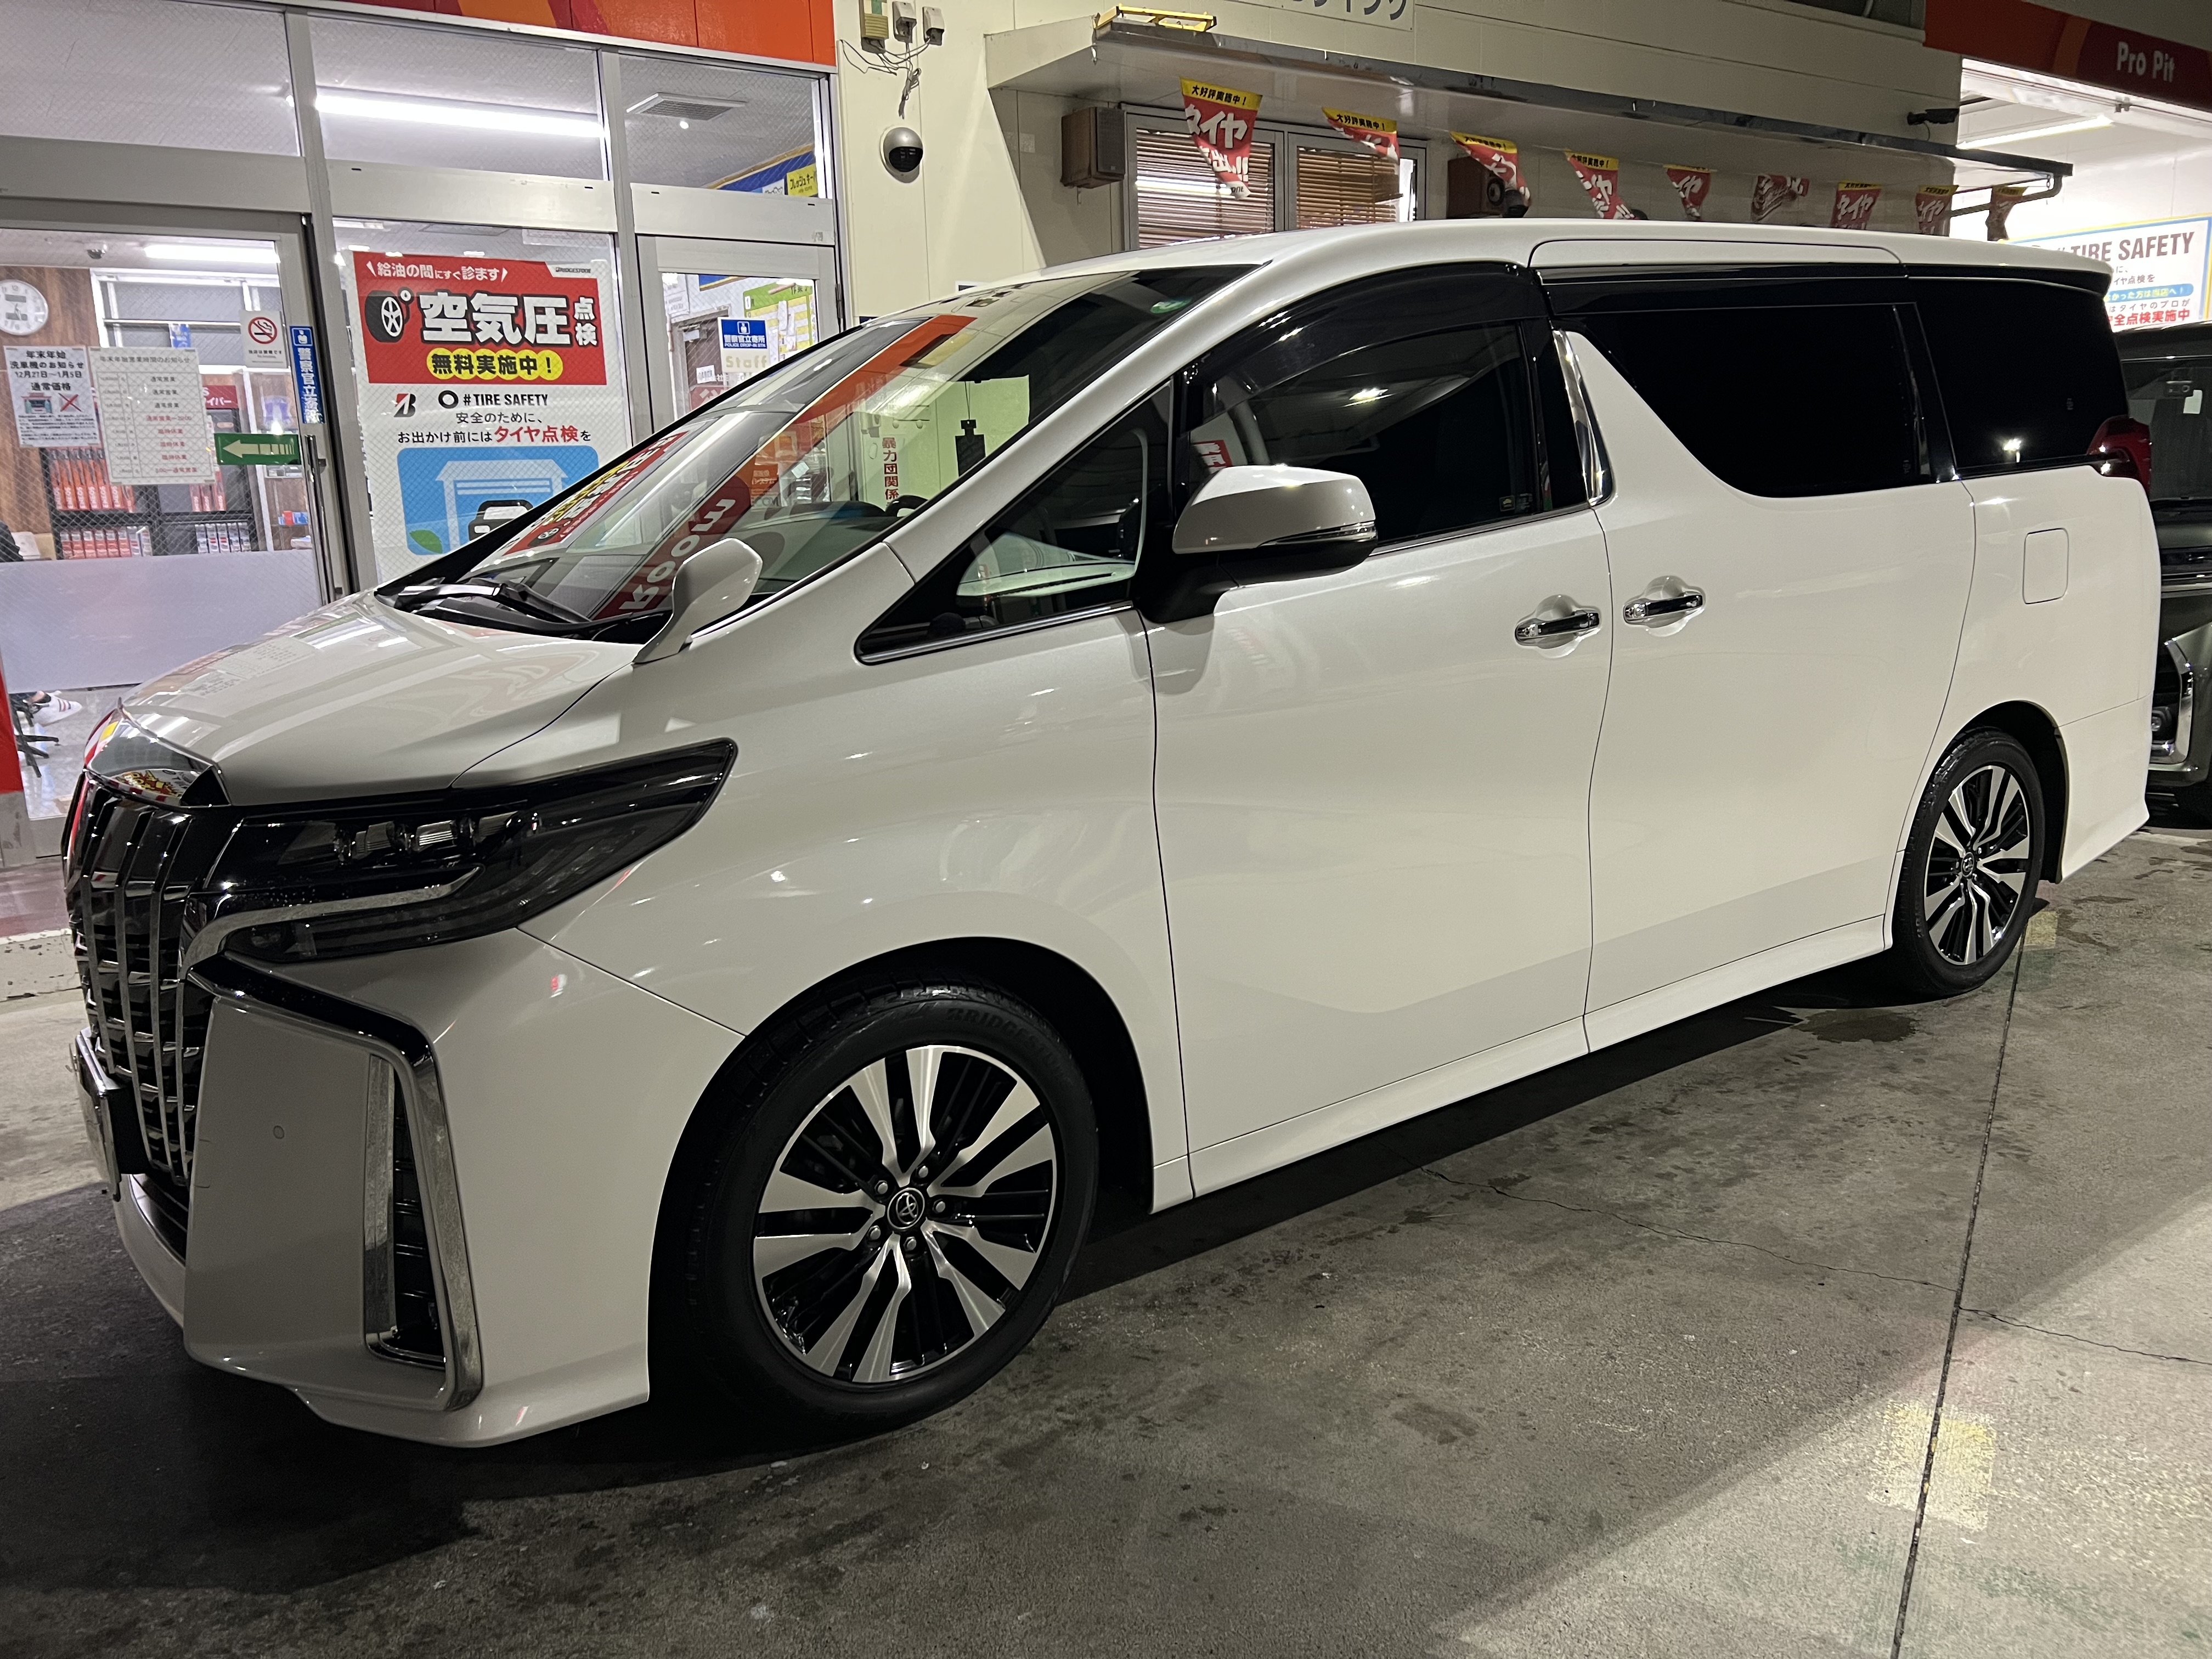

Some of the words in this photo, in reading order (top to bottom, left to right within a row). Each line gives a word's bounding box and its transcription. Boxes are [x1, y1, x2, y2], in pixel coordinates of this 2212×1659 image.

[2117, 41, 2146, 76] Pro
[2152, 50, 2175, 83] Pit
[2118, 232, 2194, 261] SAFETY
[419, 291, 571, 345] 空気圧
[26, 351, 66, 359] 年末年始
[431, 353, 552, 375] 無料実施中！
[726, 355, 768, 368] Staff
[504, 394, 548, 407] SAFETY
[456, 412, 543, 425] 安全のために、
[398, 425, 591, 444] お出かけ前にはタイヤ点検を
